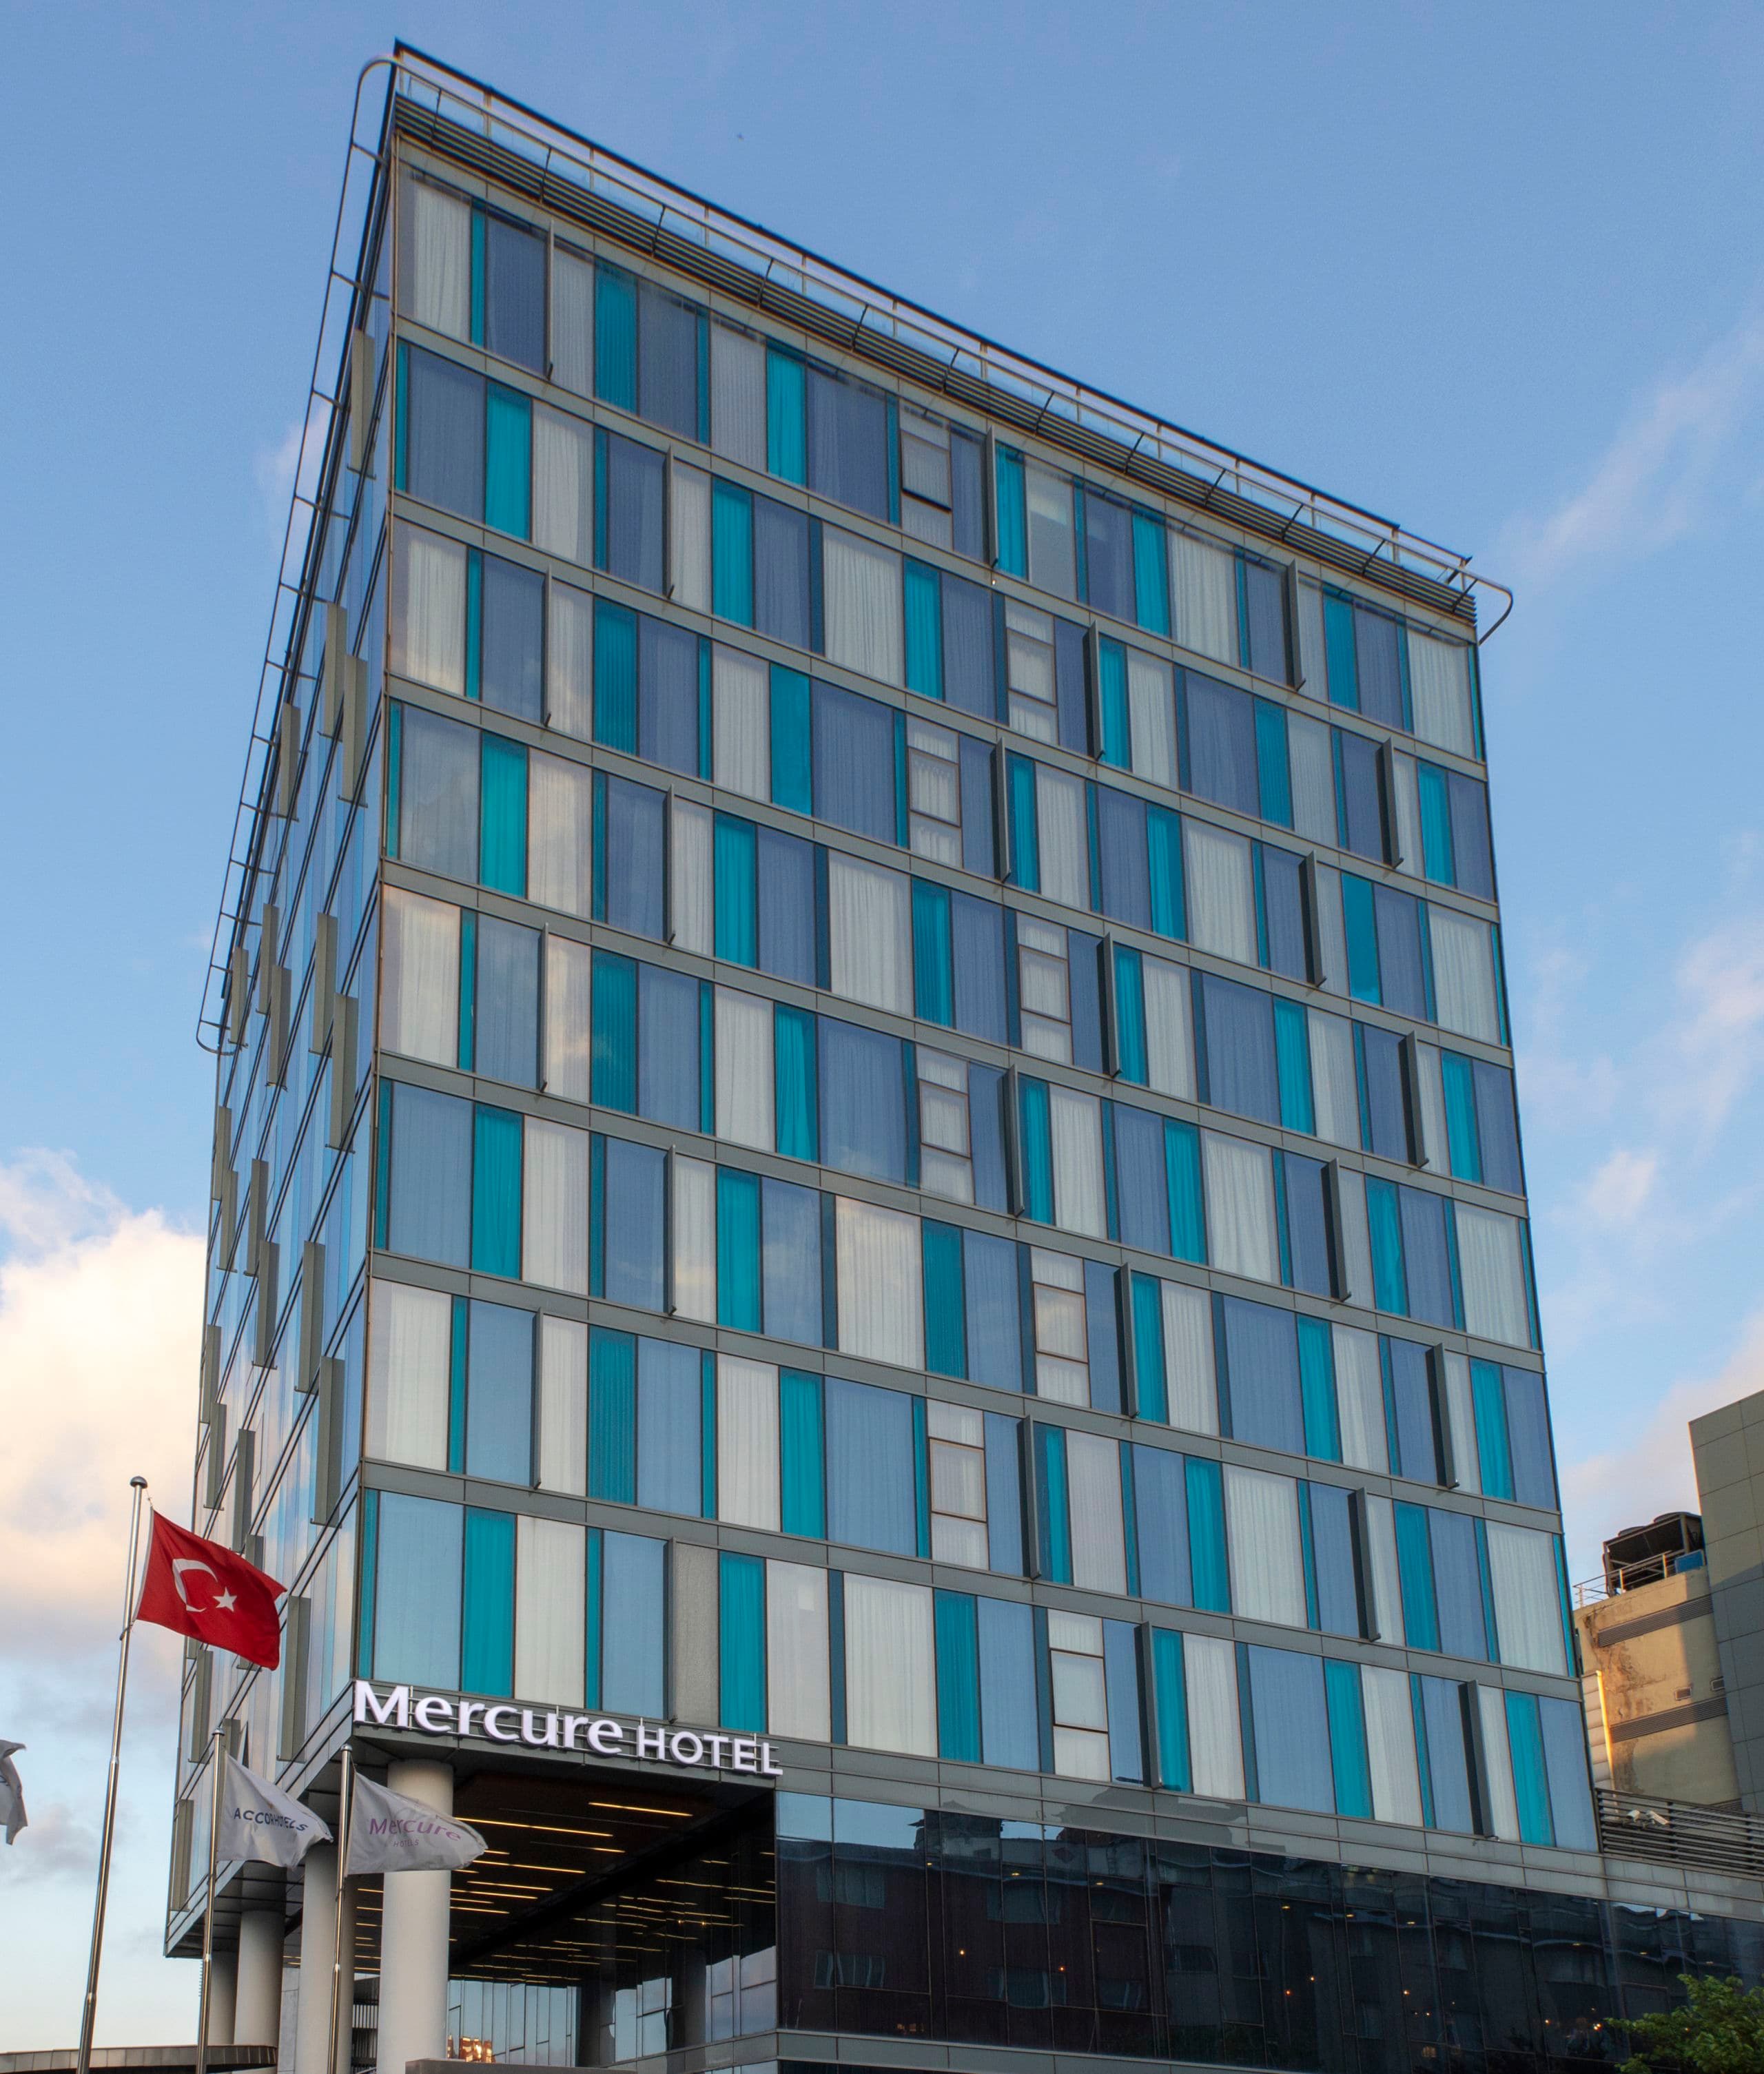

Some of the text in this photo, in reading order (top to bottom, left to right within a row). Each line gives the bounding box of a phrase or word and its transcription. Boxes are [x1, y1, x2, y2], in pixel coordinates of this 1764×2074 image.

[353, 1680, 783, 1776] Mercure HOTEL
[234, 1807, 309, 1831] ACCORHOTELS
[369, 1818, 461, 1841] Mercure
[393, 1839, 420, 1847] HOTELS
